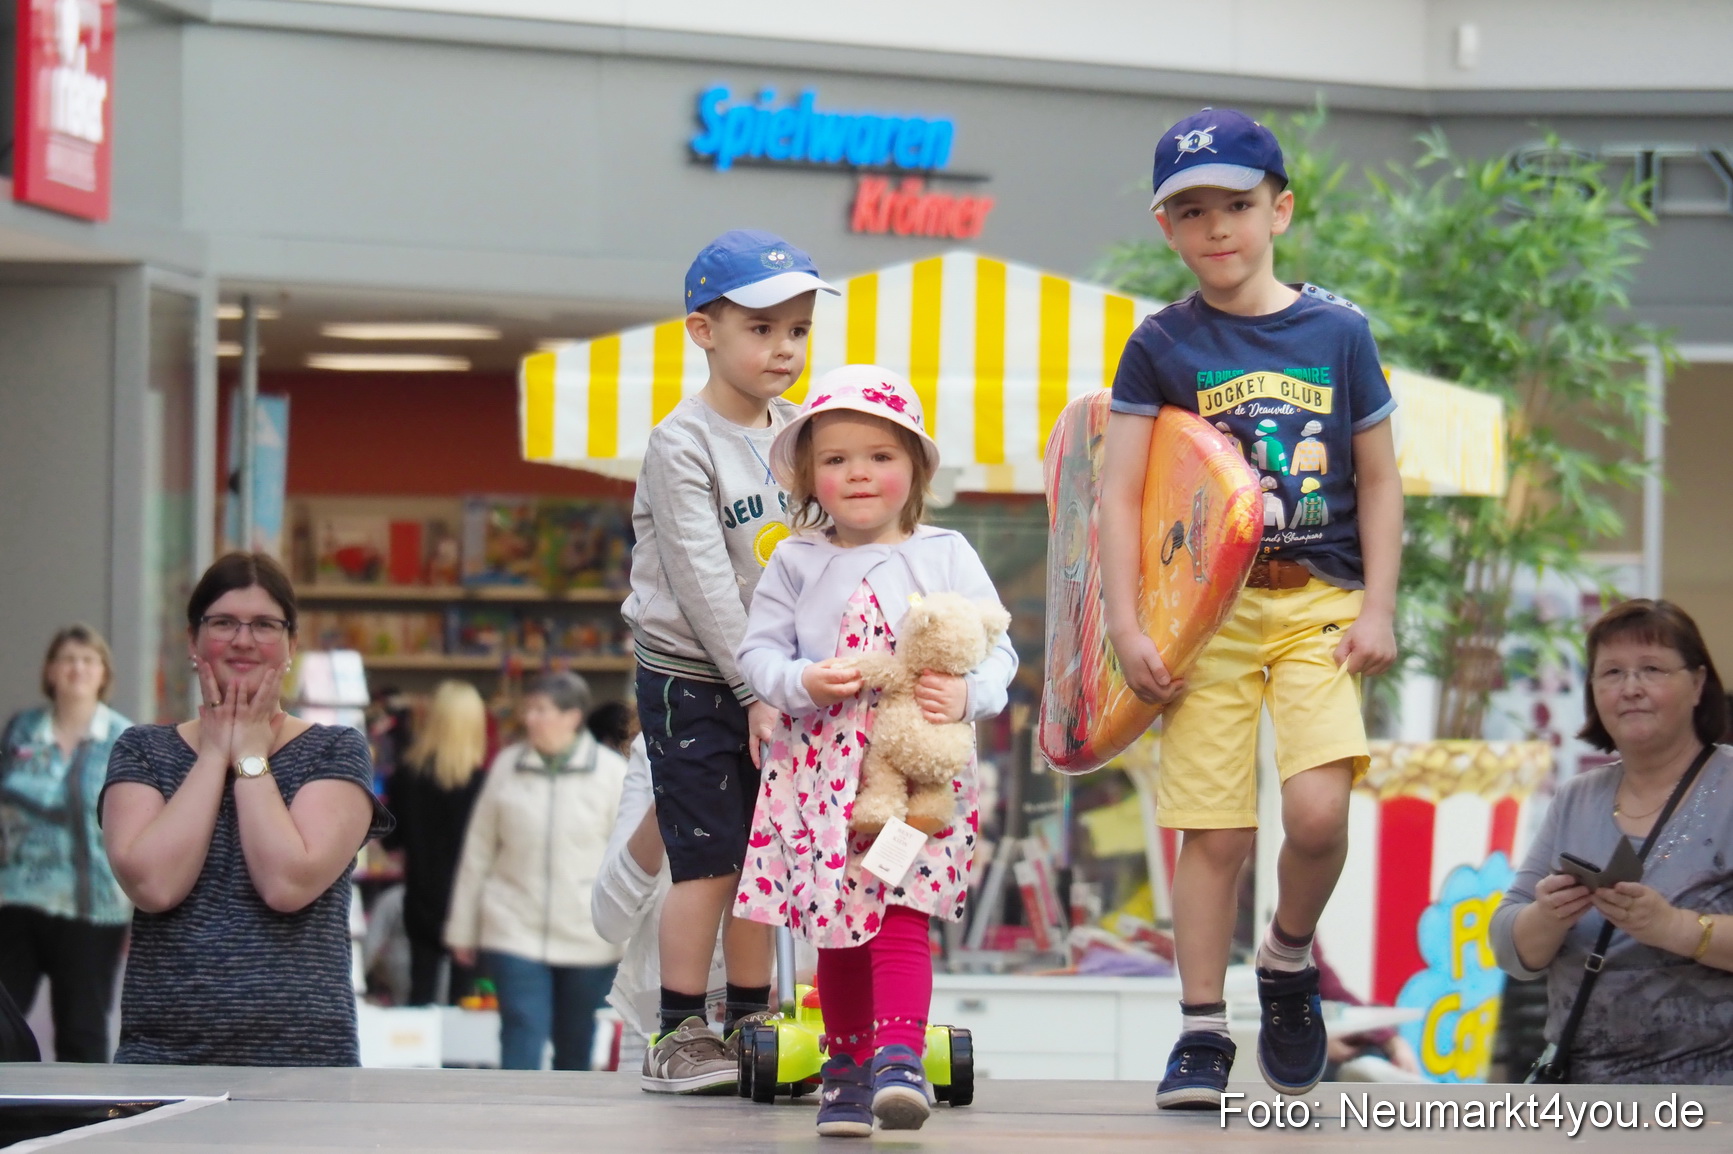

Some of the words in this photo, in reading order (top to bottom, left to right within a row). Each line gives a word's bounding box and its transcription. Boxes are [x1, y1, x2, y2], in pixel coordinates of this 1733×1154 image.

[691, 87, 955, 171] Spielwaren
[852, 175, 993, 238] Krömer
[1205, 376, 1265, 411] JOCKEY
[1280, 381, 1322, 407] CLUB
[1234, 404, 1246, 415] de
[724, 494, 763, 529] JEU
[1282, 530, 1323, 544] Champions
